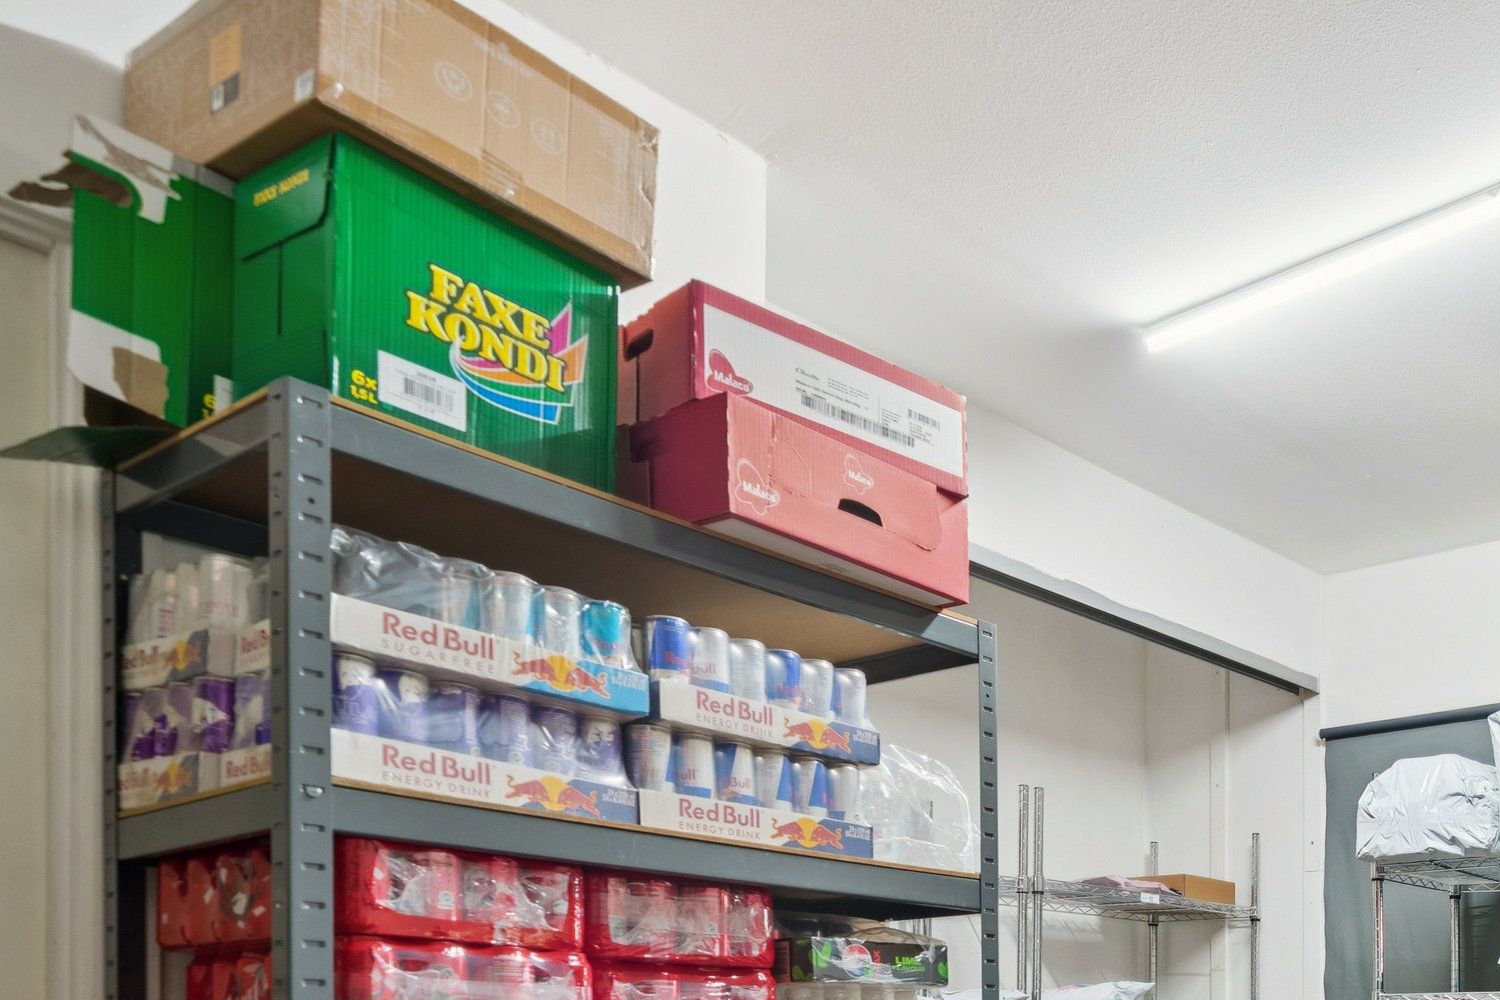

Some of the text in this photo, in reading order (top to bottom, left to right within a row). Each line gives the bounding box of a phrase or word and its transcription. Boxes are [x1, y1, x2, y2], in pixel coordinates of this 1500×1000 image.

[429, 264, 551, 350] FAXE
[406, 290, 566, 393] KONDI
[713, 369, 750, 392] Malaco
[742, 481, 777, 503] Malaco
[847, 470, 873, 488] Malaco
[382, 612, 494, 660] Red Bull
[382, 640, 495, 675] SUGARFREE
[696, 690, 773, 727] Red Bull
[696, 712, 774, 738] ENERGY DRINK
[382, 744, 491, 785] Red Bull
[382, 770, 491, 798] ENERGY DRINK
[679, 798, 760, 828] Red Bull
[679, 821, 760, 840] ENERGY DRINK
